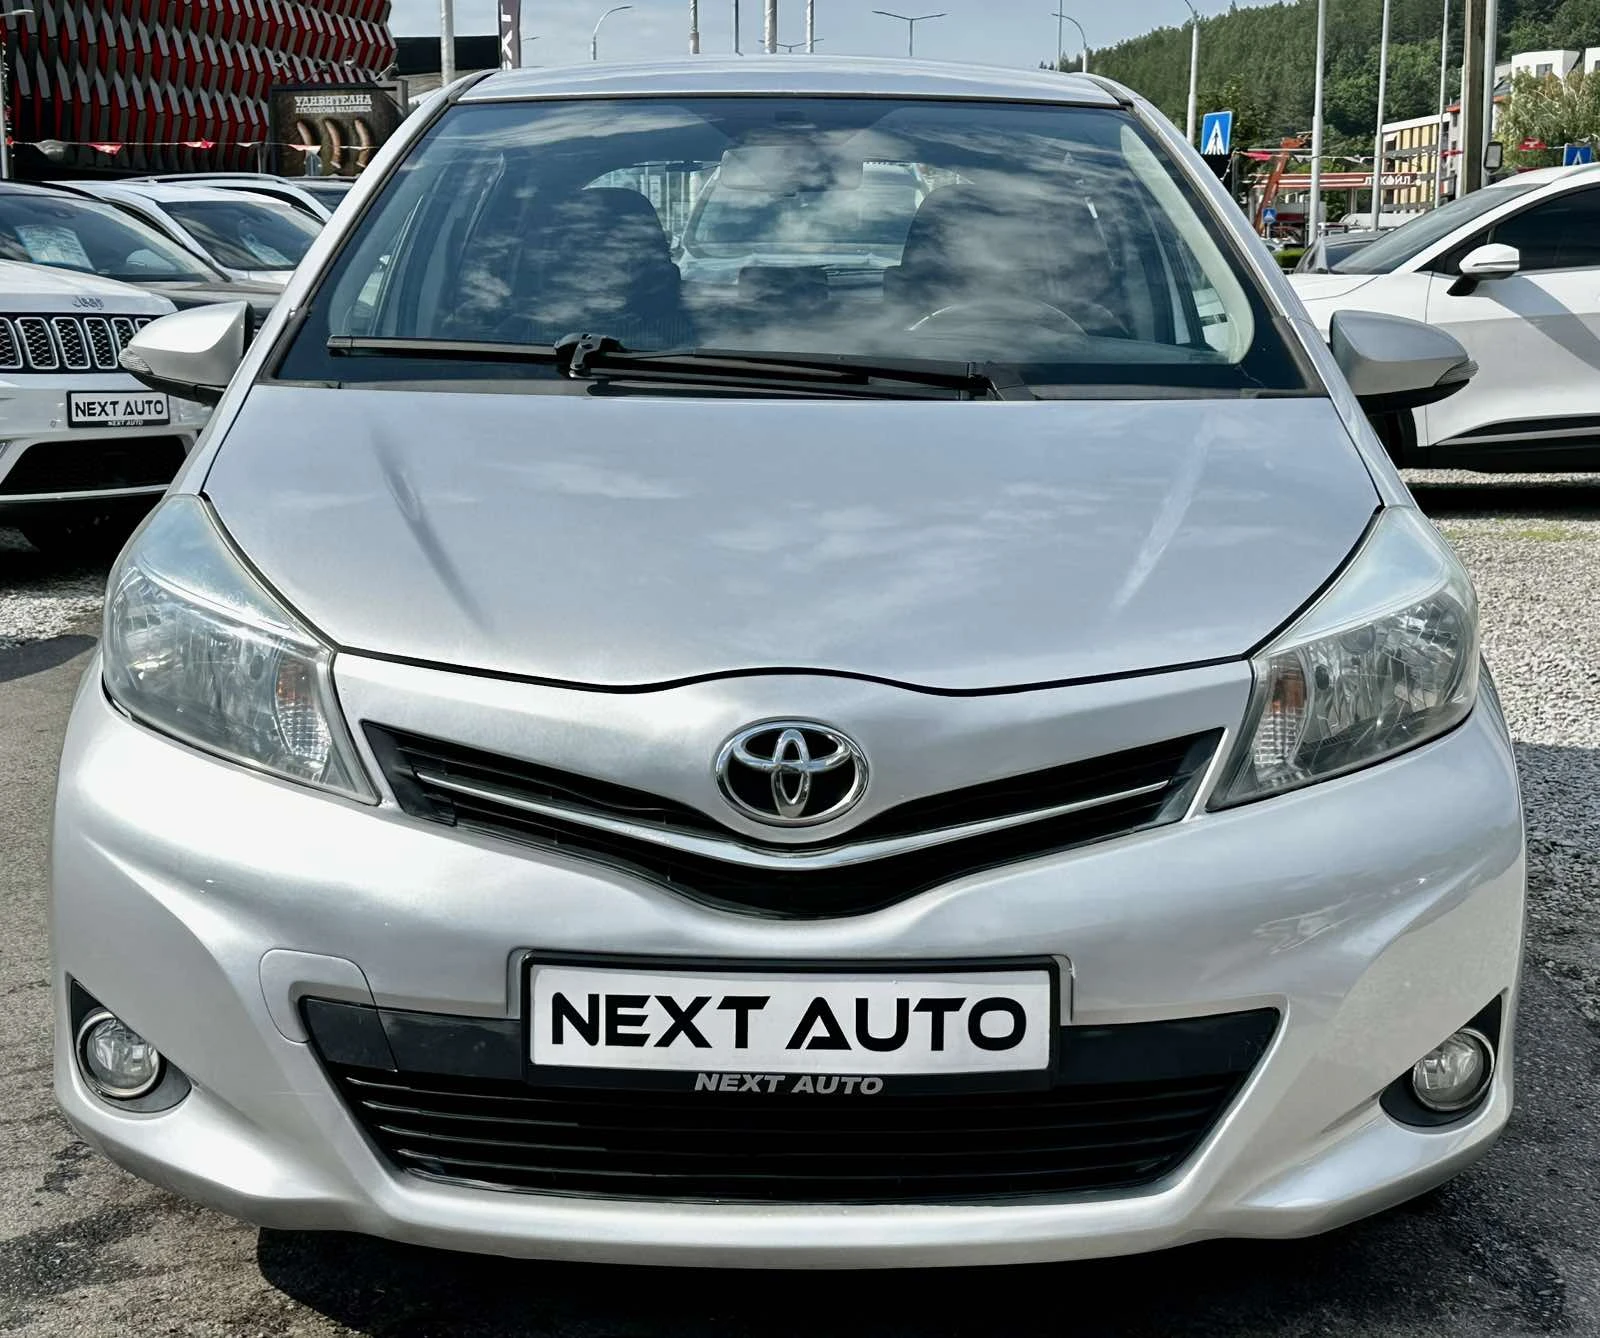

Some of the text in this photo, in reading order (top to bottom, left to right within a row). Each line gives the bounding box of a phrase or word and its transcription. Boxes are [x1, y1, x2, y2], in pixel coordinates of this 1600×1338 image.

[75, 399, 164, 417] NEXT AUTO
[551, 991, 1027, 1052] NEXT AUTO
[694, 1072, 884, 1096] NEXT AUTO
